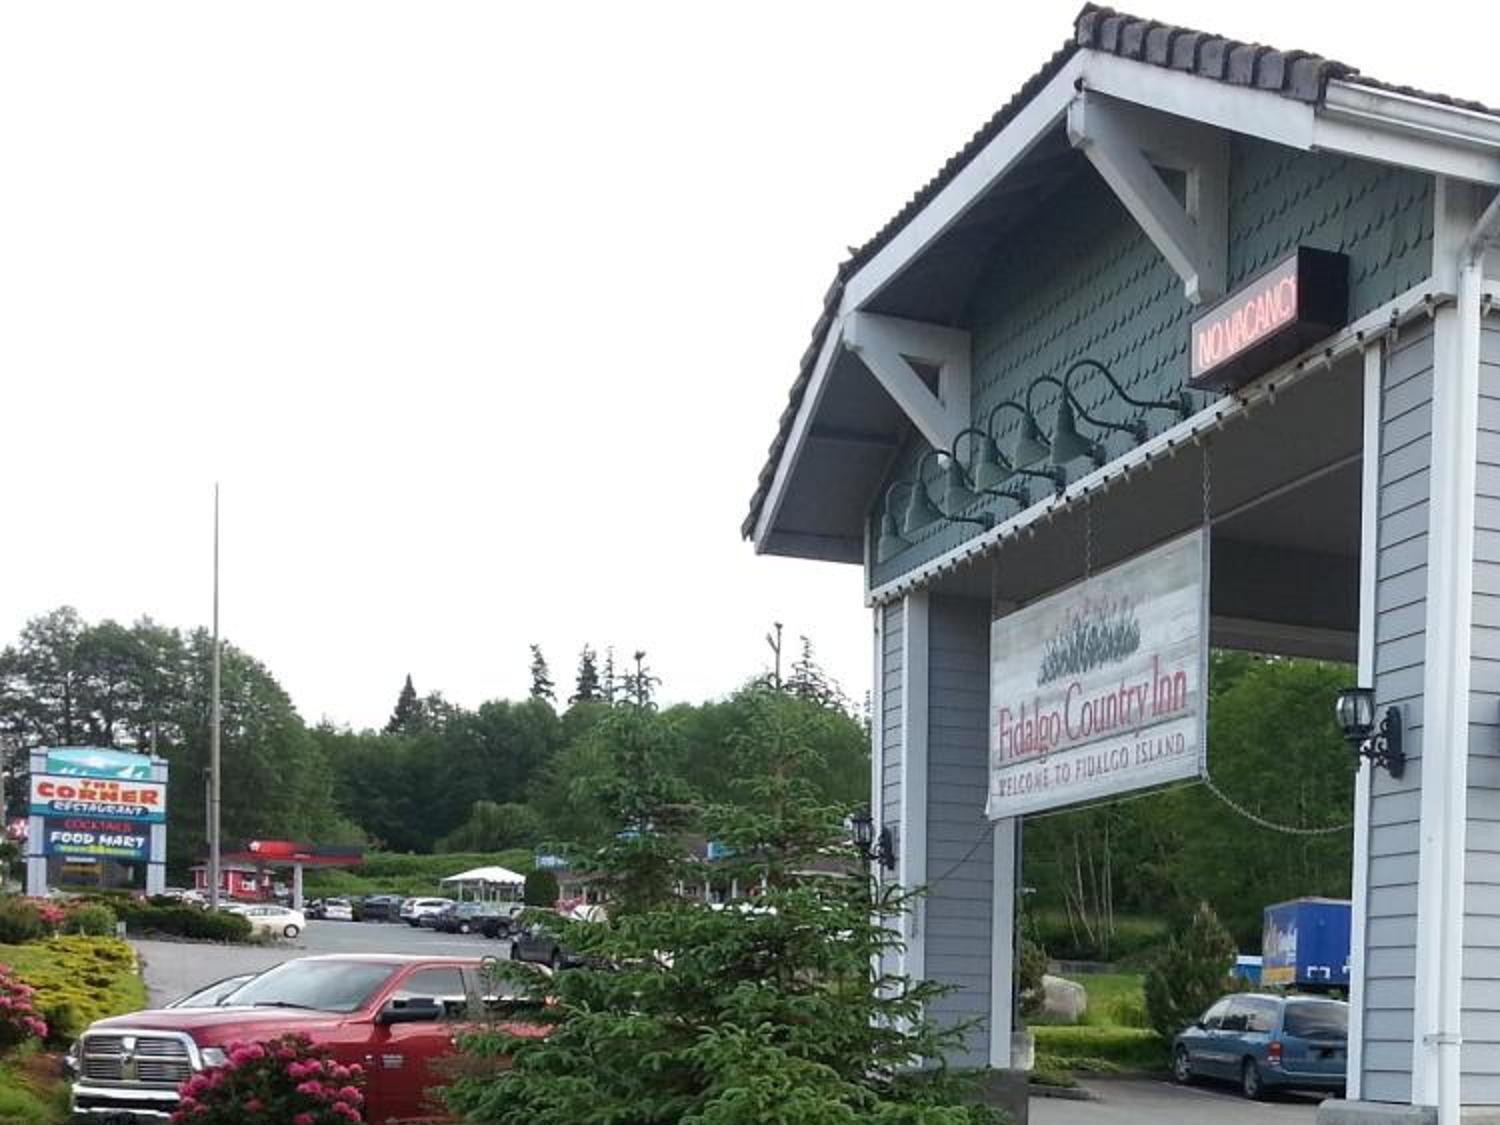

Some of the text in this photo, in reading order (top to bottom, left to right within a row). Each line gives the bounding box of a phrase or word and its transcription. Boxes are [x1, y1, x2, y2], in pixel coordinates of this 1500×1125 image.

[1198, 322, 1223, 369] NO
[998, 655, 1187, 764] Fidalgo Country Inn
[999, 733, 1185, 797] WELCOME TO FIDALGO ISLAND
[37, 782, 159, 804] CORNER
[82, 780, 119, 789] THE
[54, 801, 143, 815] RESTAURANT
[51, 831, 145, 848] FOOD MART
